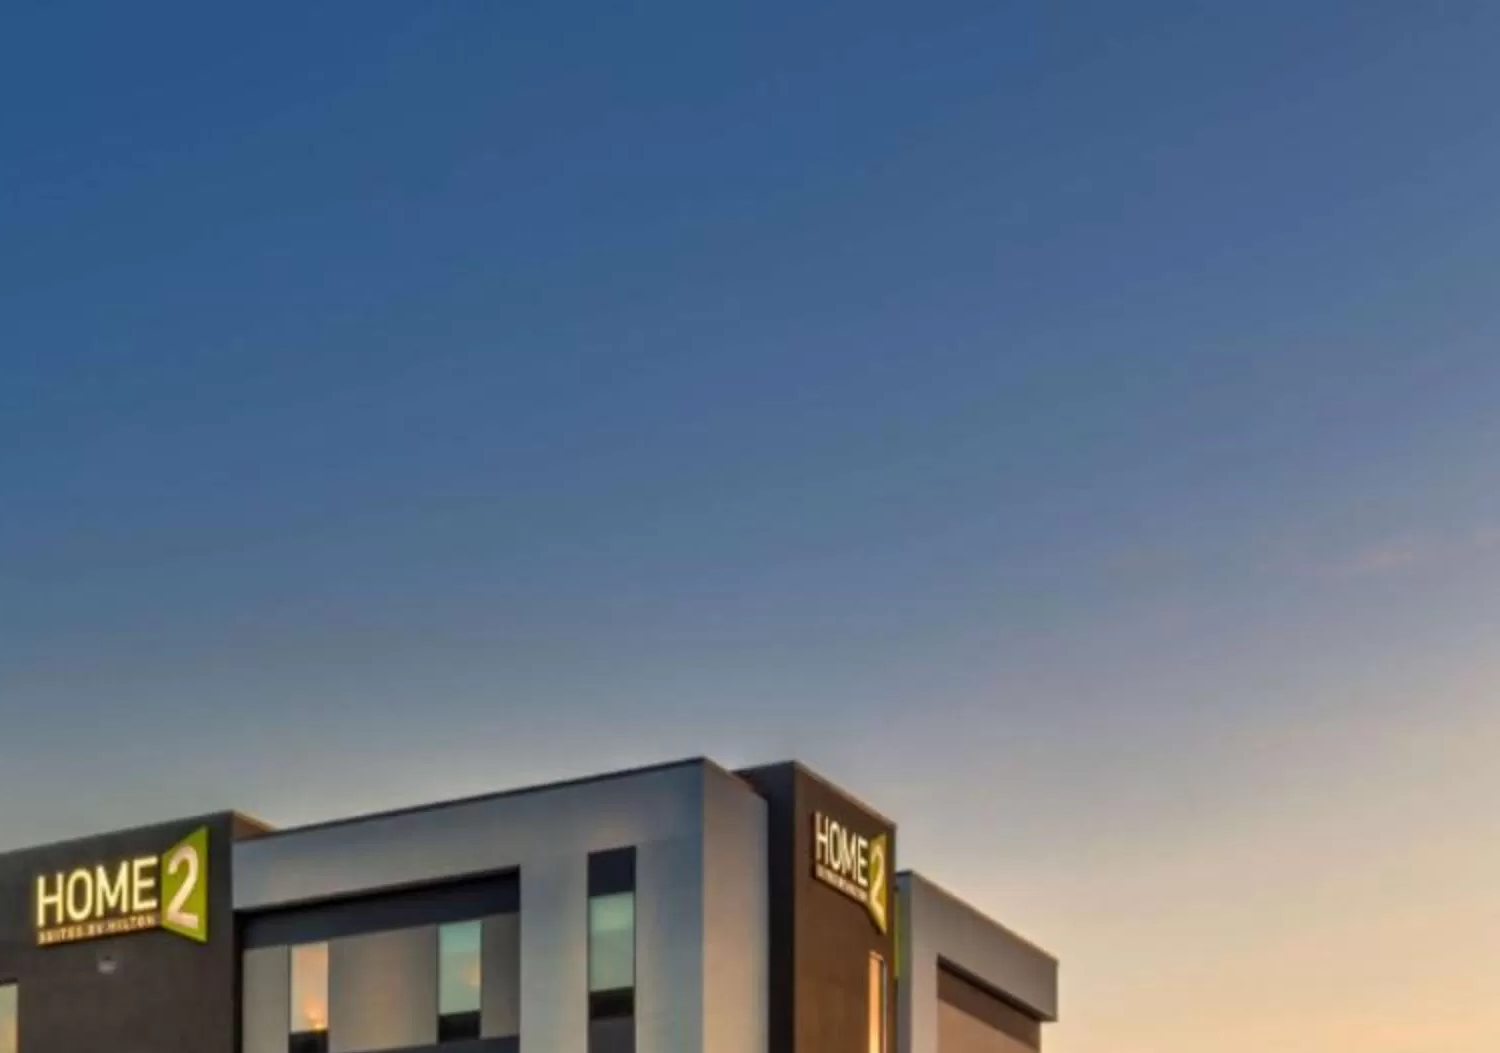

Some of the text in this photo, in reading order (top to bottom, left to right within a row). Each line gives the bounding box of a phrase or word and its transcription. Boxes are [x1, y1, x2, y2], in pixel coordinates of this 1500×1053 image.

[36, 844, 198, 929] HOME 2
[815, 811, 868, 887] HOME
